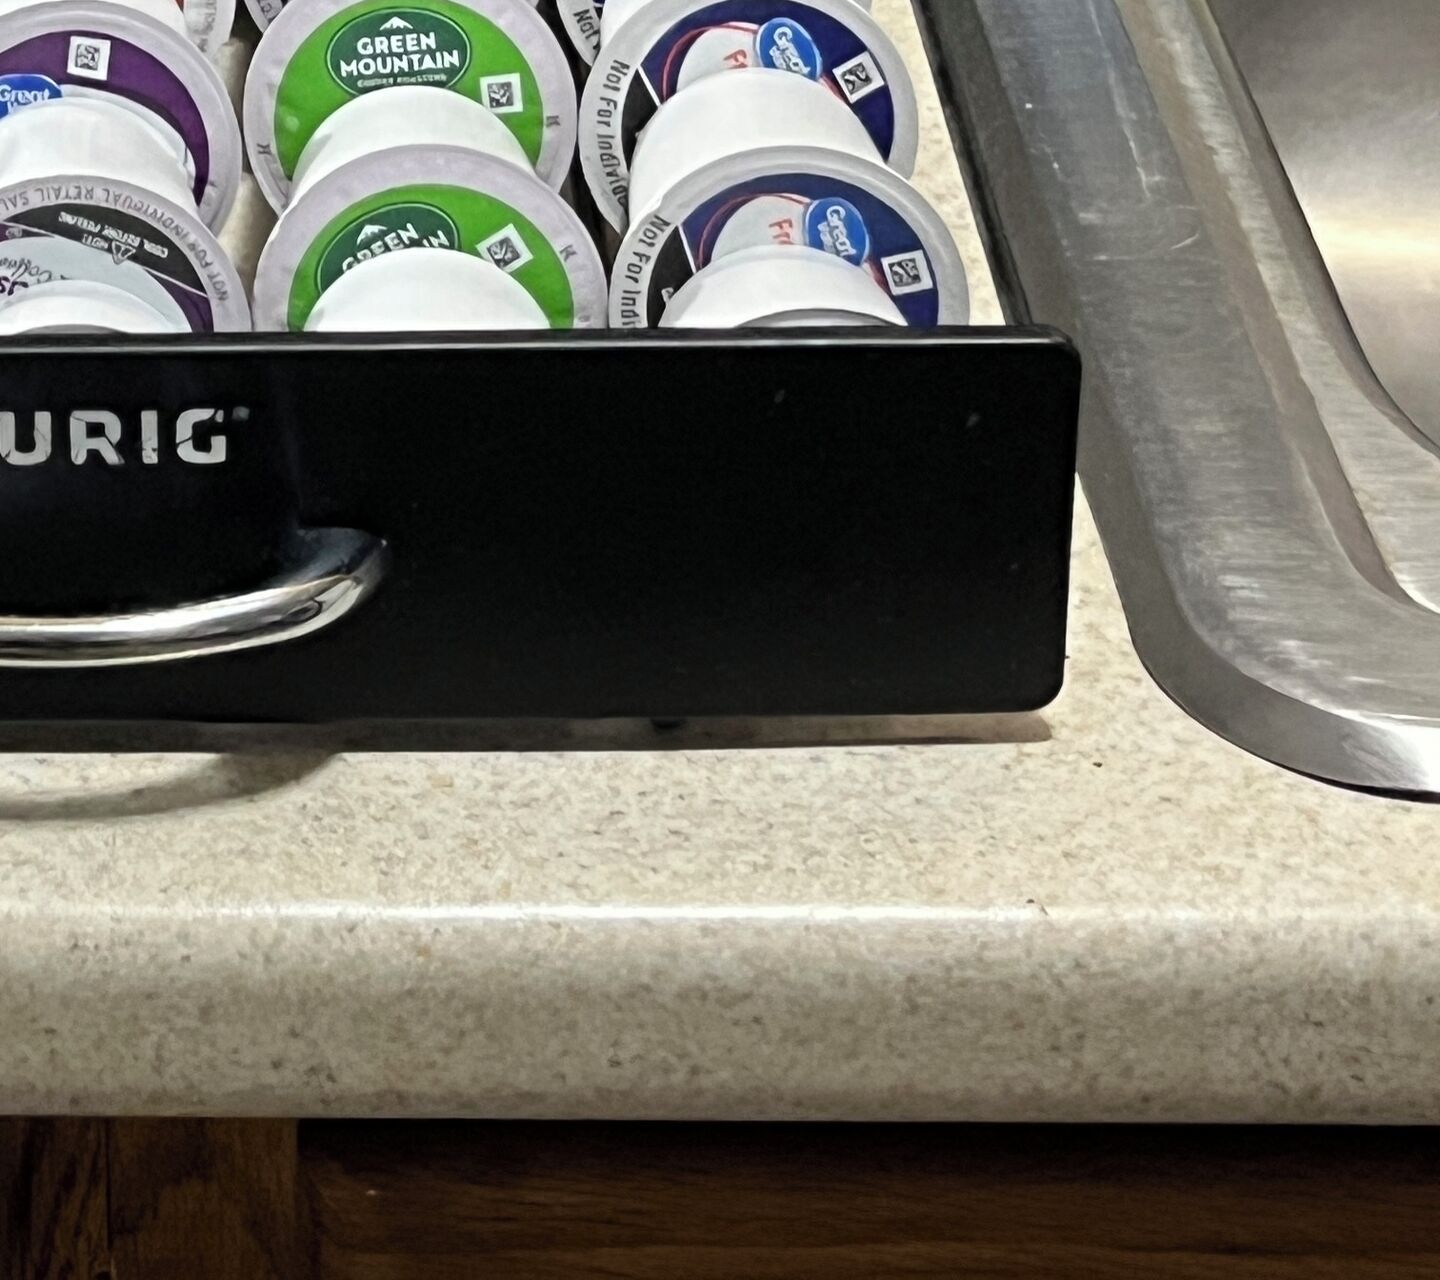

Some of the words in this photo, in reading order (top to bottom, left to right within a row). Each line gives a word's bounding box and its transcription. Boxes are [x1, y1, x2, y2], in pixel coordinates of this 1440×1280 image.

[357, 31, 437, 56] GREEN
[339, 49, 461, 78] MOUNTAIN
[606, 59, 630, 91] Not
[596, 97, 618, 127] For
[36, 185, 95, 203] RETAIL
[101, 188, 192, 240] INDIVIDUAL
[639, 214, 672, 248] Not
[625, 250, 651, 284] For
[206, 270, 229, 303] NOT
